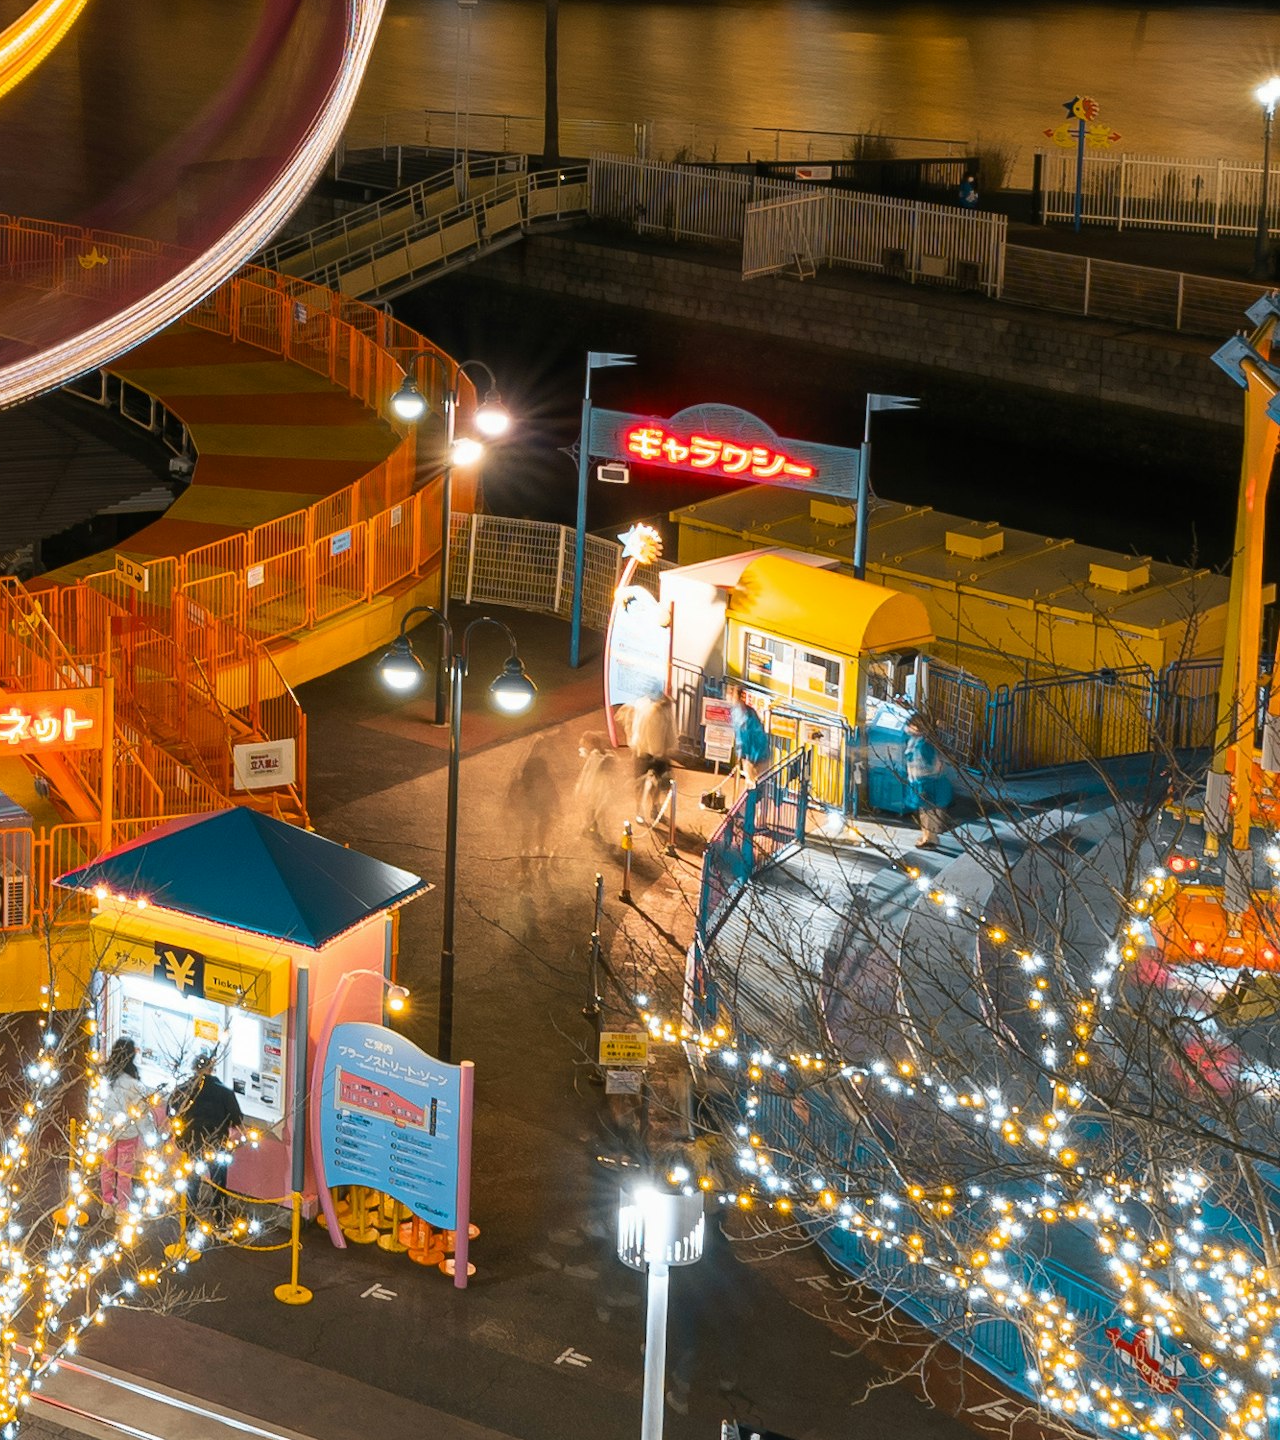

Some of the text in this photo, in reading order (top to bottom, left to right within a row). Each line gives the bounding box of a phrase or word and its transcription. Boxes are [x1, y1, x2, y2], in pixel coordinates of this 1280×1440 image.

[117, 558, 134, 576] 出口
[250, 758, 280, 770] 立入禁止
[364, 1038, 394, 1056] ご案内
